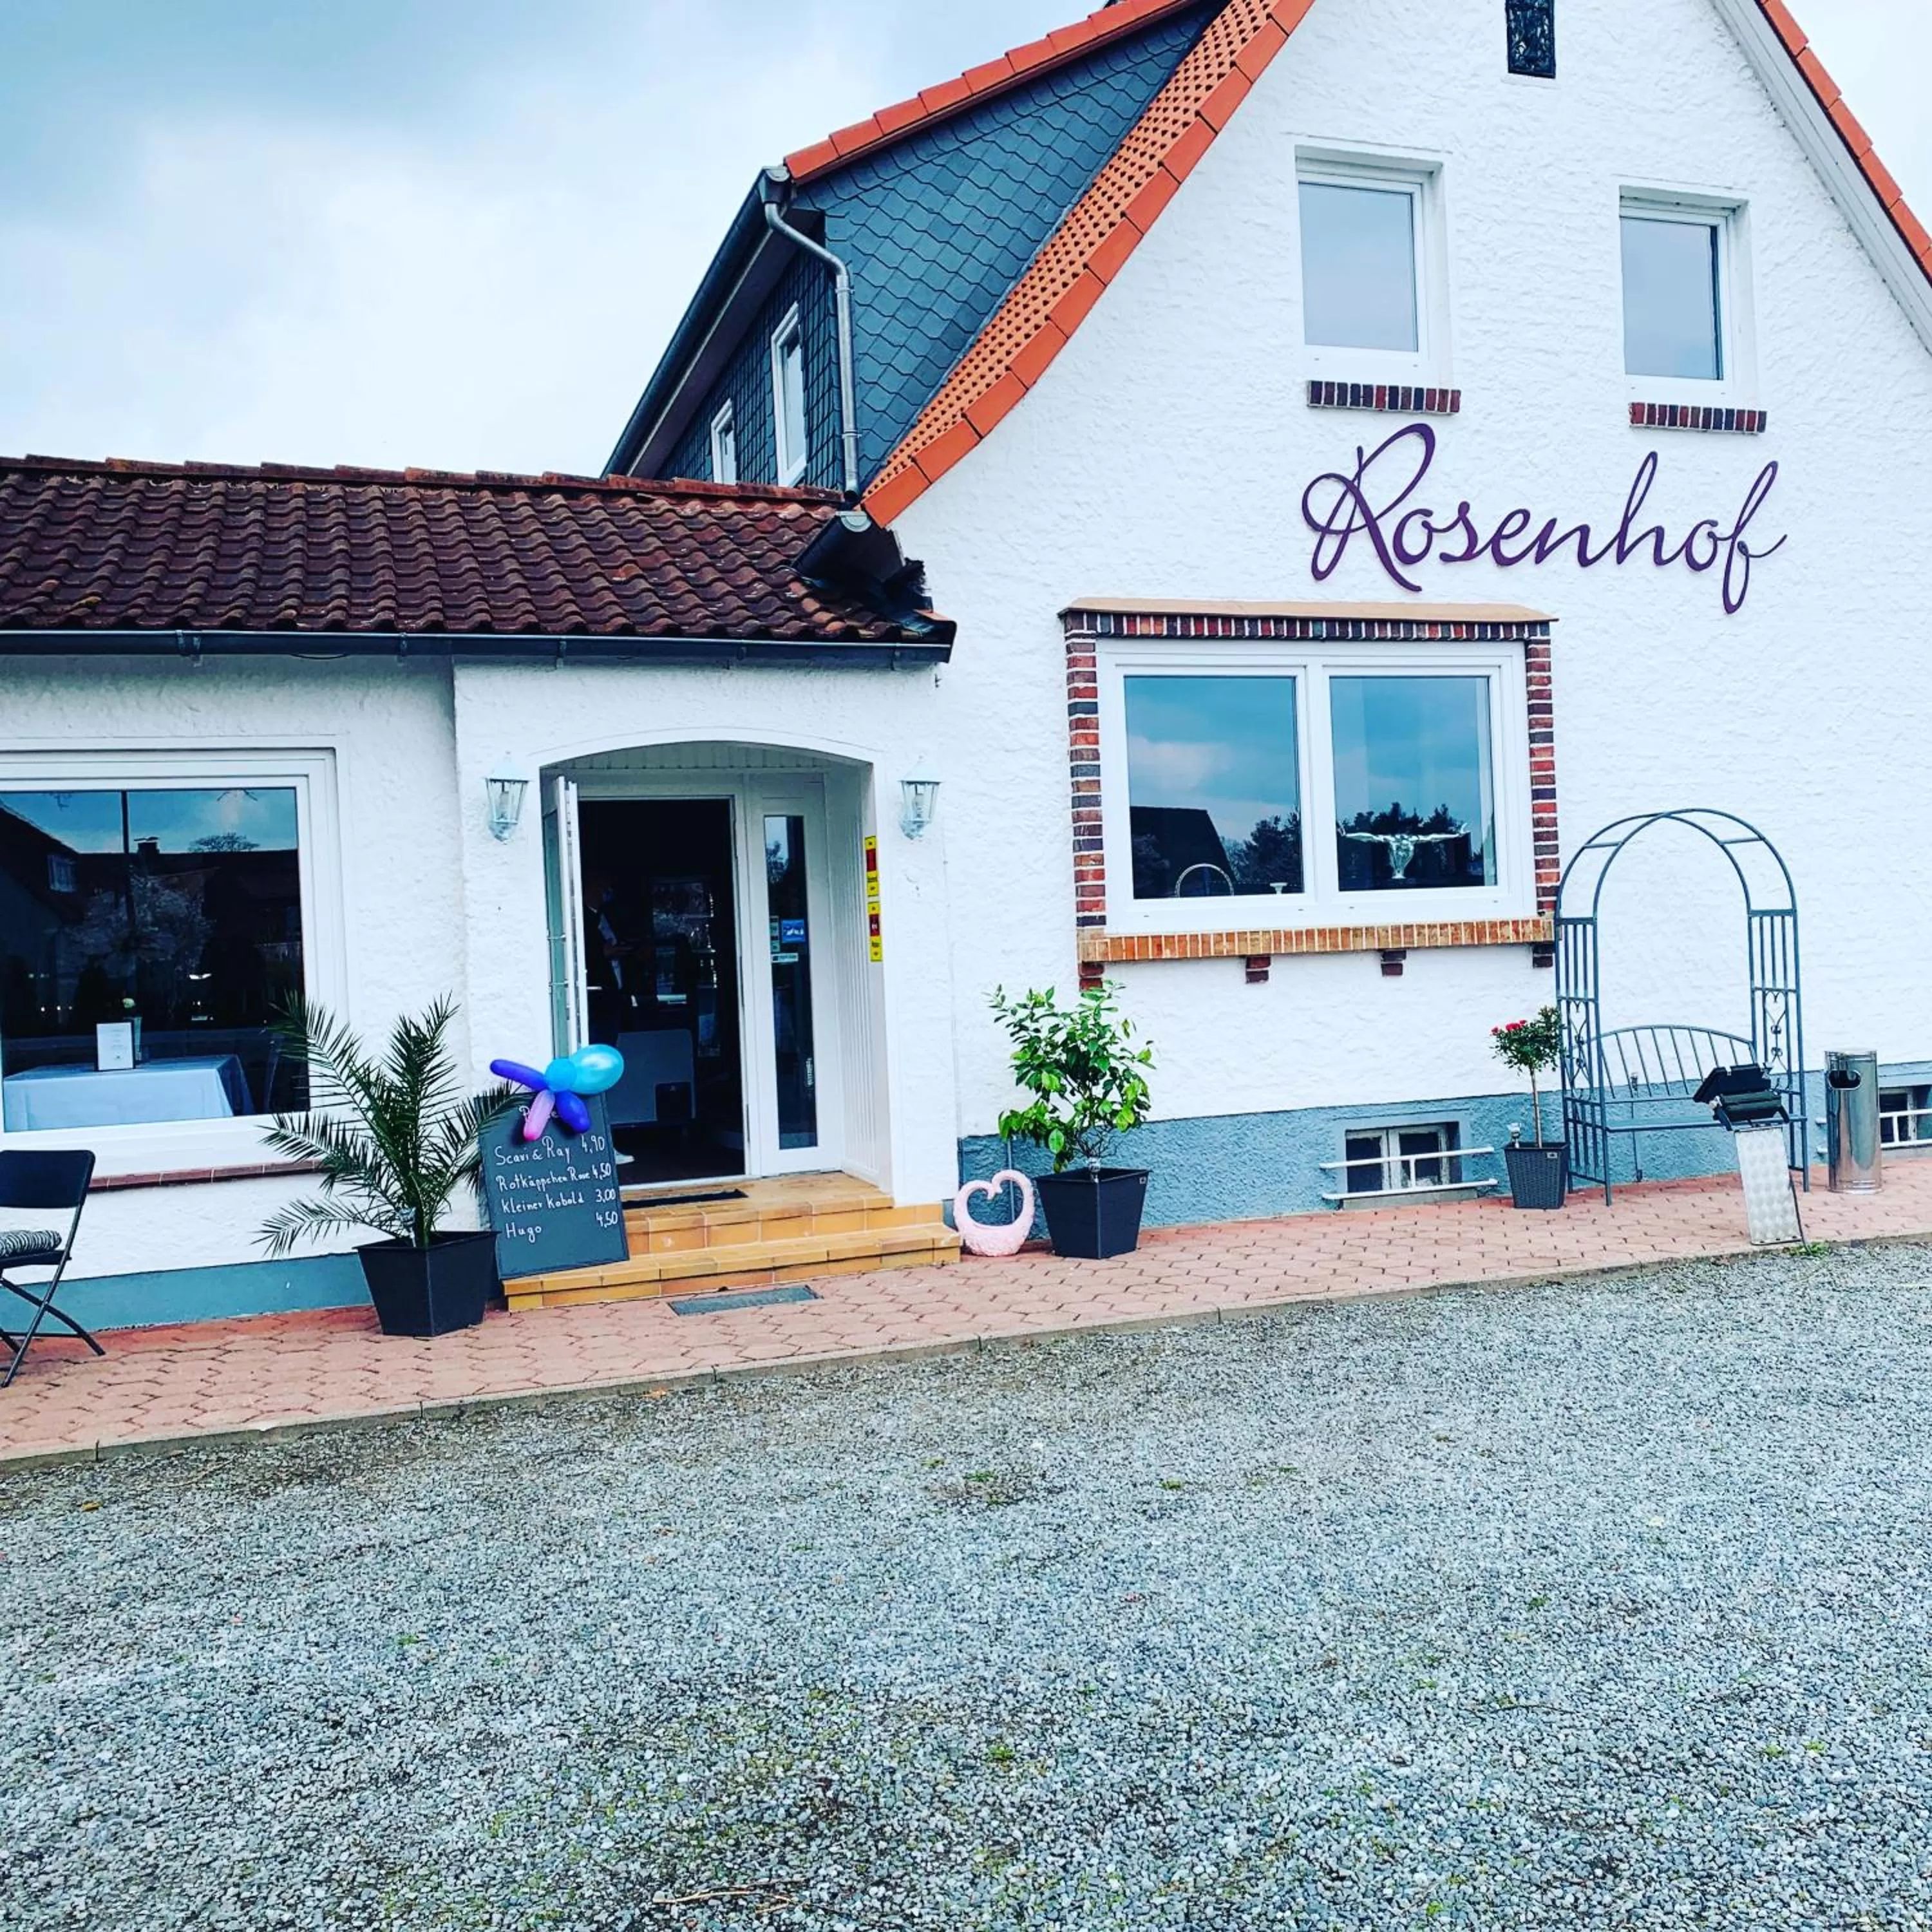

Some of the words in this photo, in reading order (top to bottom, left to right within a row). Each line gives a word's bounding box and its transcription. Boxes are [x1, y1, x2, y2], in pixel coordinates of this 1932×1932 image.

[1302, 423, 1788, 614] Rosenhof
[532, 1148, 545, 1160] &
[542, 1135, 571, 1164] Ray
[581, 1135, 605, 1154] 4,90
[592, 1162, 612, 1180] 4,50
[595, 1188, 616, 1204] 3,00
[506, 1222, 542, 1244] Hugo
[596, 1211, 618, 1228] 4,50
